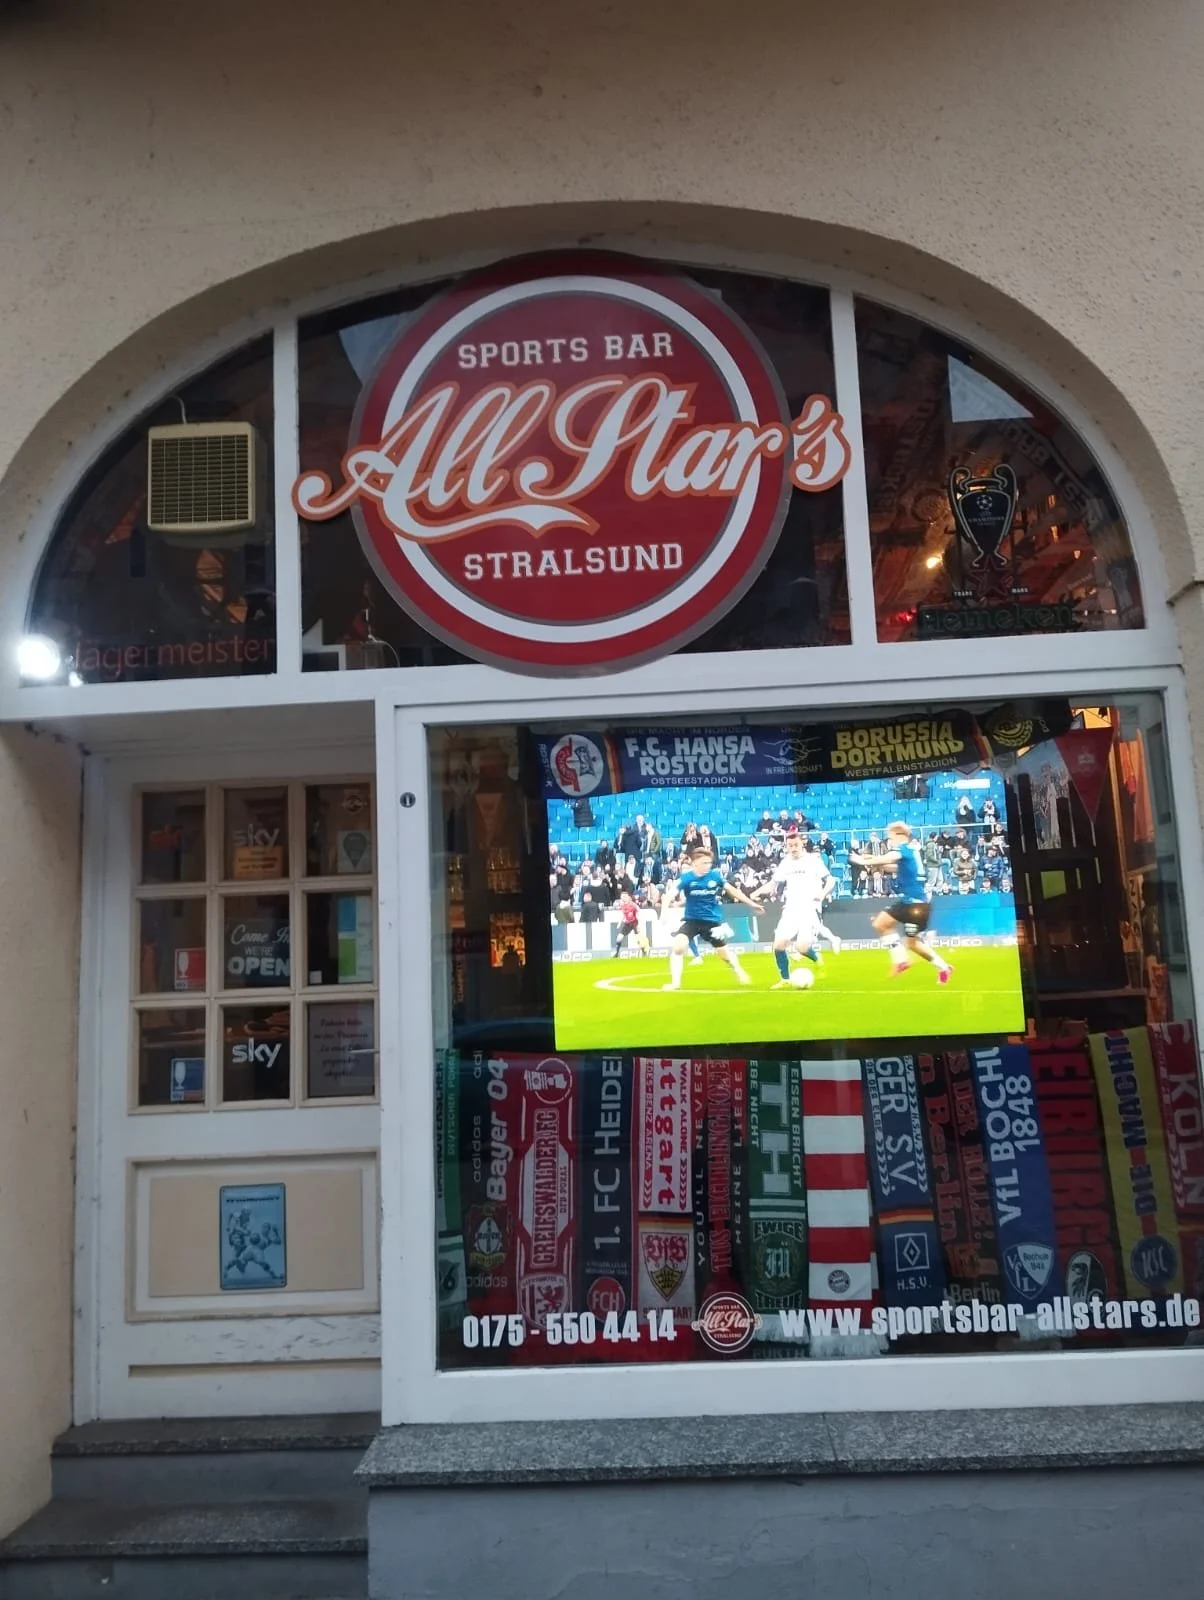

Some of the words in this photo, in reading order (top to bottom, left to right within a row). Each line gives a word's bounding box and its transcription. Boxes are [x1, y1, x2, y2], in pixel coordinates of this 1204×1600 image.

[458, 337, 589, 370] SPORTS
[604, 332, 675, 361] BAR
[292, 378, 558, 537] All
[514, 373, 853, 502] Star's
[464, 543, 684, 580] STRALSUND
[922, 603, 1074, 633] Heineken
[625, 737, 667, 757] F.C.
[674, 735, 756, 755] HANSA
[830, 740, 965, 769] DORTMUND
[836, 720, 955, 749] BORUSSIA
[639, 755, 746, 776] ROSTOCK
[650, 775, 737, 786] OSTSEESTADION
[844, 756, 958, 777] WESTFALENSTADION
[231, 923, 269, 945] Come
[228, 956, 290, 976] OPEN
[231, 1038, 283, 1068] sky
[487, 1057, 509, 1100] 04
[791, 1068, 800, 1118] EISEN
[1104, 1037, 1148, 1149] MACHT
[535, 1110, 557, 1132] FC
[694, 1063, 703, 1149] NEVER
[733, 1071, 743, 1148] LIEBE
[750, 1096, 760, 1148] NICHT
[1005, 1073, 1041, 1153] 1848
[471, 1114, 481, 1183] adidas
[486, 1112, 513, 1201] Bayer
[791, 1124, 802, 1188] BRICHT
[885, 1133, 918, 1192] S.V.
[533, 1136, 557, 1265] GREIFSWALDER
[593, 1167, 621, 1213] FC
[732, 1164, 742, 1244] MEINE
[994, 1167, 1023, 1227] VfL
[1129, 1165, 1157, 1216] DIE
[594, 1225, 621, 1250] 1.
[695, 1167, 706, 1266] YOU'LL
[896, 1274, 933, 1291] H.S.V.
[1141, 1243, 1168, 1279] KSC
[592, 1290, 620, 1312] FCH
[949, 1281, 1001, 1303] Berlin
[462, 1313, 525, 1349] 0175
[545, 1311, 597, 1346] 550
[602, 1309, 641, 1343] 44
[646, 1308, 678, 1343] 14
[779, 1293, 1201, 1340] www.sportsbar-allstars.de
